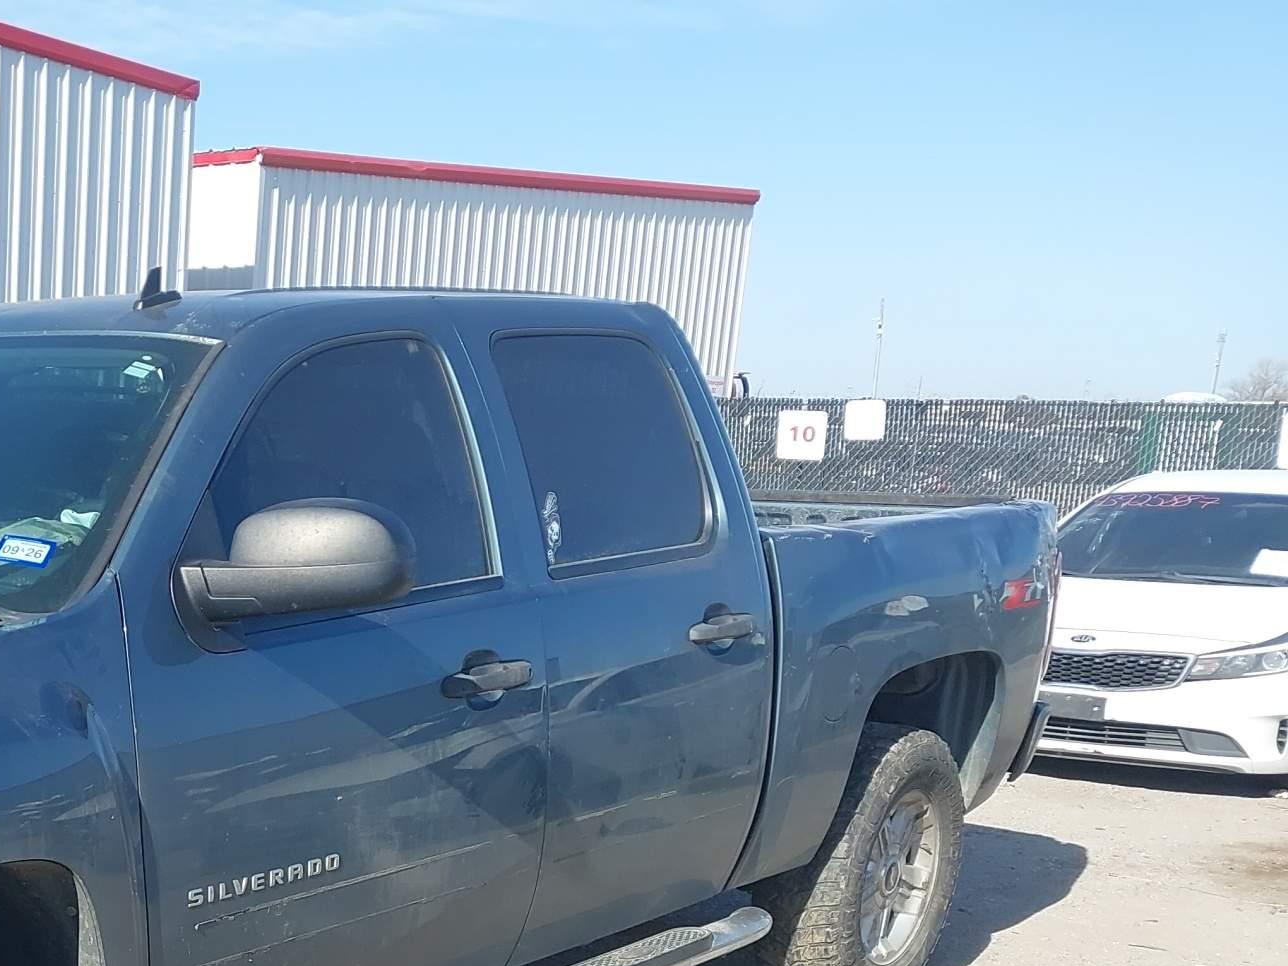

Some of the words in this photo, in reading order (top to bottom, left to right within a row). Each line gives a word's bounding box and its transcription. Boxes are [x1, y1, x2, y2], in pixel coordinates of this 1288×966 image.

[790, 426, 816, 442] 10
[2, 544, 20, 555] 09
[25, 547, 44, 559] 26
[187, 853, 340, 908] SILVERADO
